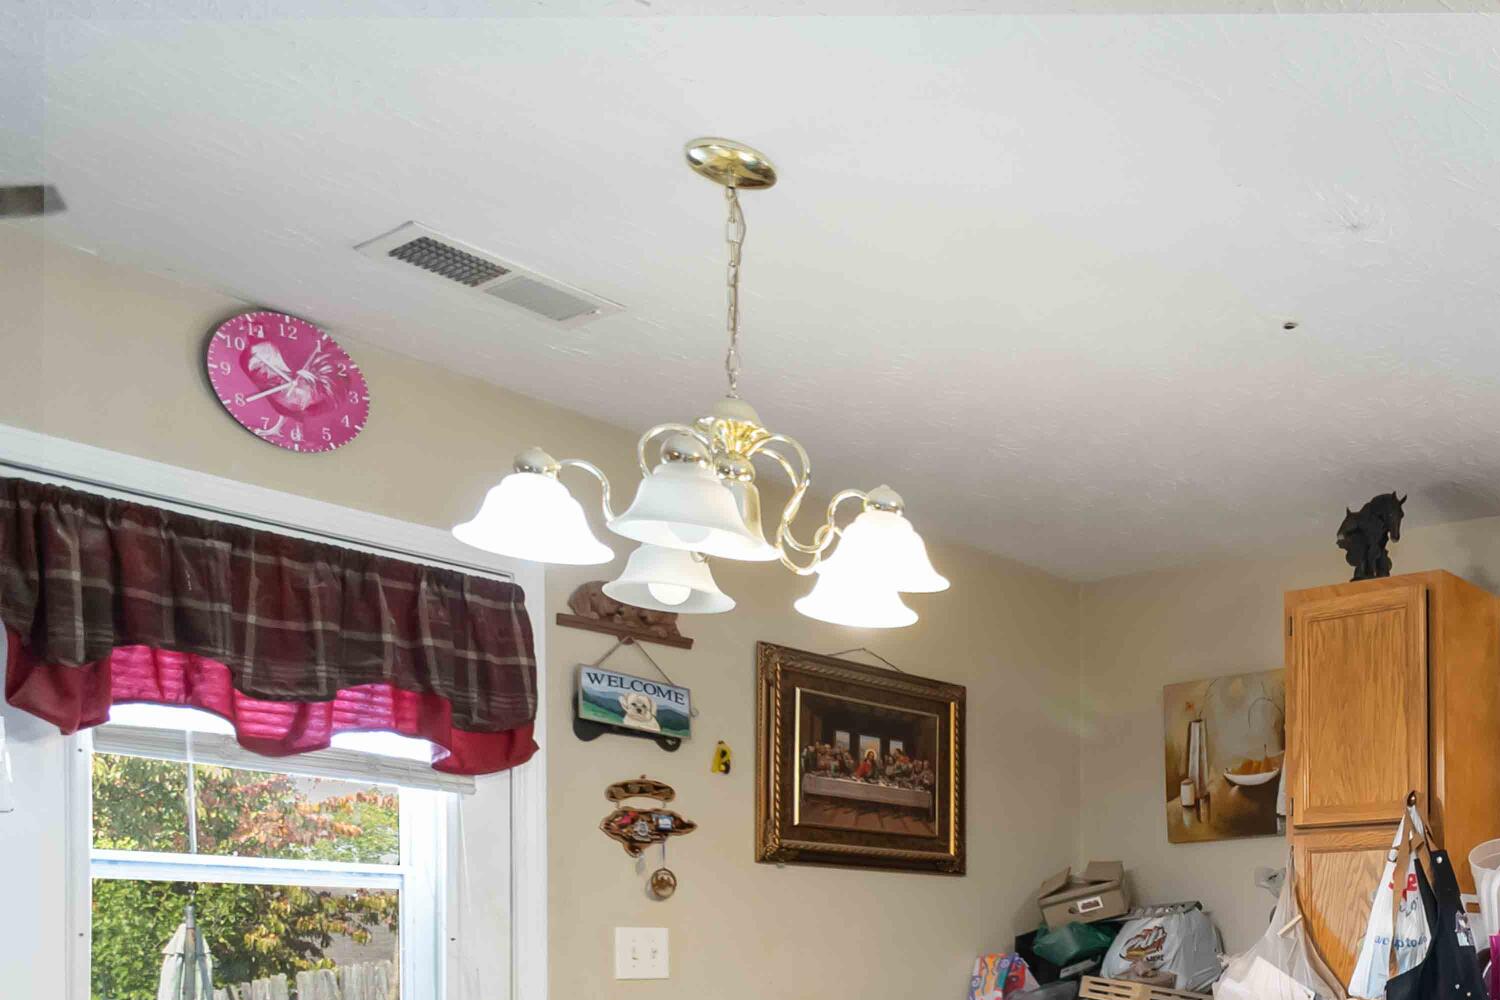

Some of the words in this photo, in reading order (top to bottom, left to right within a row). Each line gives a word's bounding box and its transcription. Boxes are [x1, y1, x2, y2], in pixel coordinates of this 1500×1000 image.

[279, 323, 298, 340] 12
[224, 335, 246, 351] 10
[315, 339, 322, 352] 1
[220, 362, 231, 376] 9
[337, 363, 347, 377] 2
[235, 392, 246, 407] 8
[349, 391, 359, 404] 3
[260, 416, 270, 430] 7
[341, 415, 350, 428] 4
[290, 425, 302, 441] 6
[321, 427, 332, 441] 5
[586, 672, 685, 706] WELCOME
